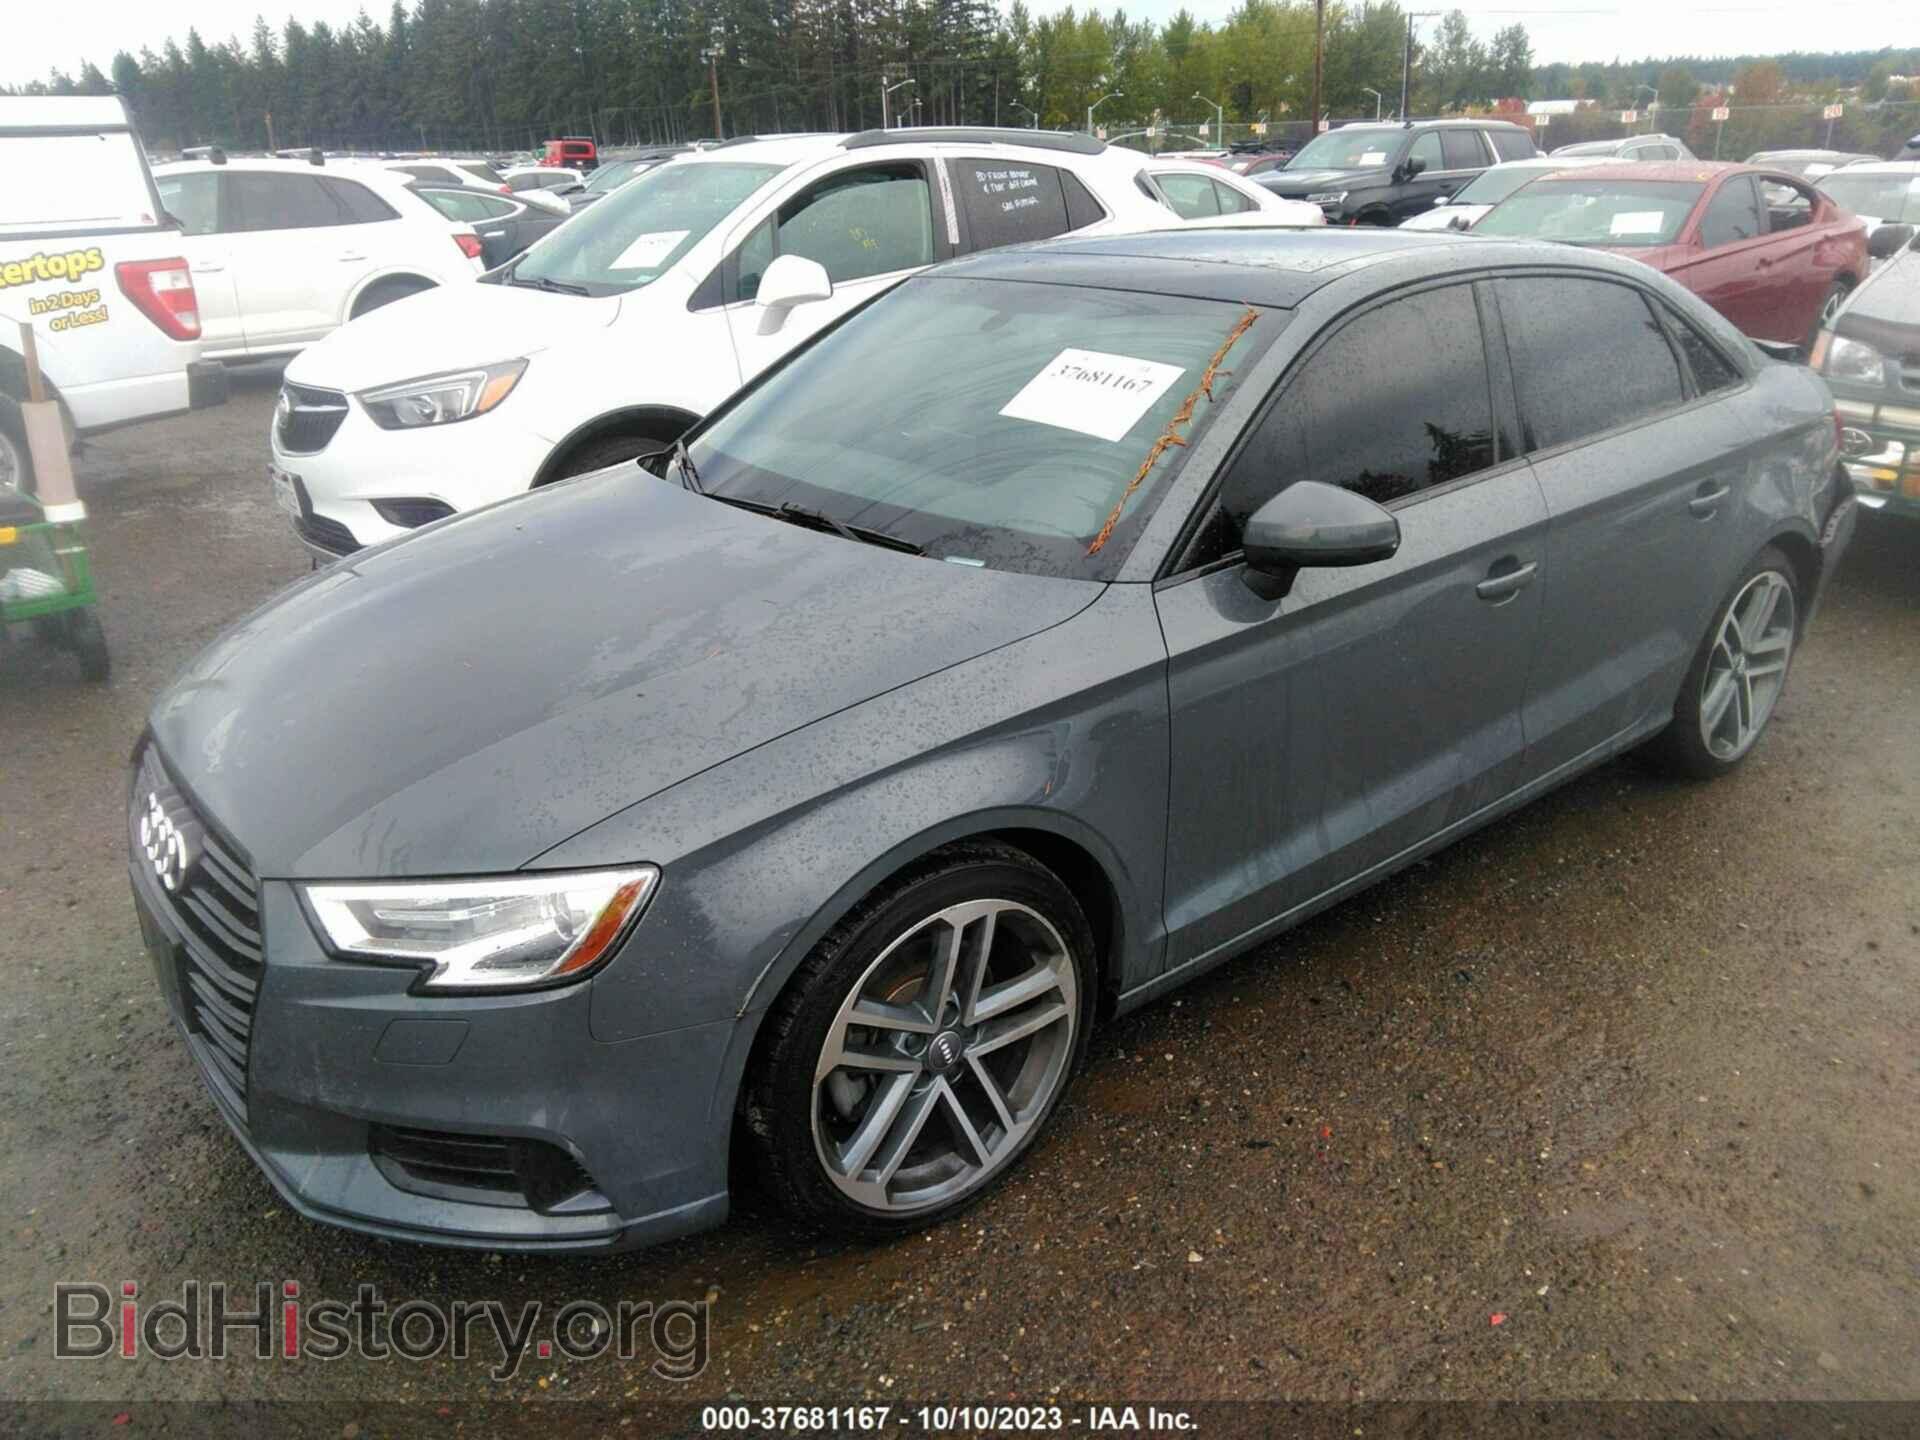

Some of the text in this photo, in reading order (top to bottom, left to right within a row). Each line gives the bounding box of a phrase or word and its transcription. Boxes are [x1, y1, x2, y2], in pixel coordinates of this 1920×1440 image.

[29, 289, 100, 315] in 2 Days
[50, 304, 109, 332] or Less!
[1060, 364, 1153, 393] 37681167
